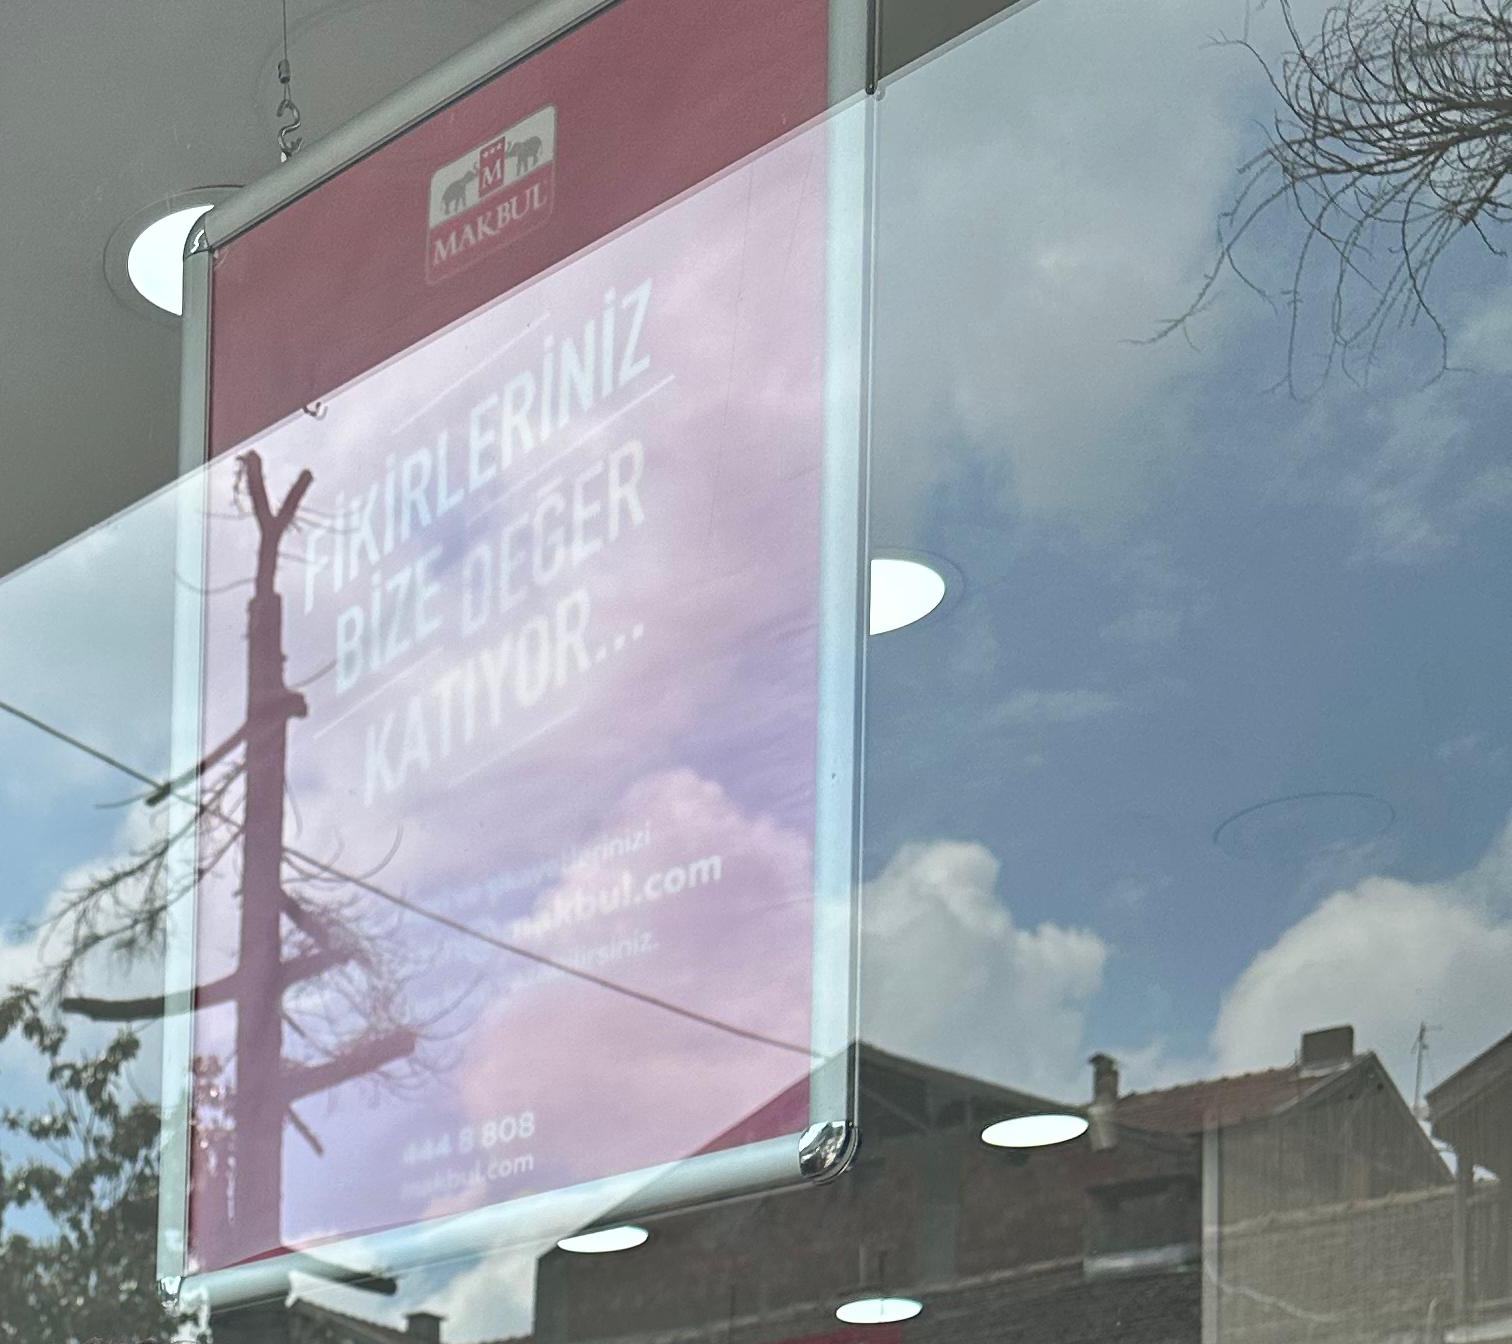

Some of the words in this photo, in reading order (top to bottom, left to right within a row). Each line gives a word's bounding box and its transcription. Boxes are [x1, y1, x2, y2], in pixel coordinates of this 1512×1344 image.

[432, 181, 545, 265] MAKBUL
[303, 277, 653, 617] FİKİRLERİNİZ
[335, 542, 444, 694] BİZE
[461, 438, 646, 639] DEĞER
[458, 1126, 475, 1155] 8
[480, 1110, 536, 1149] 808
